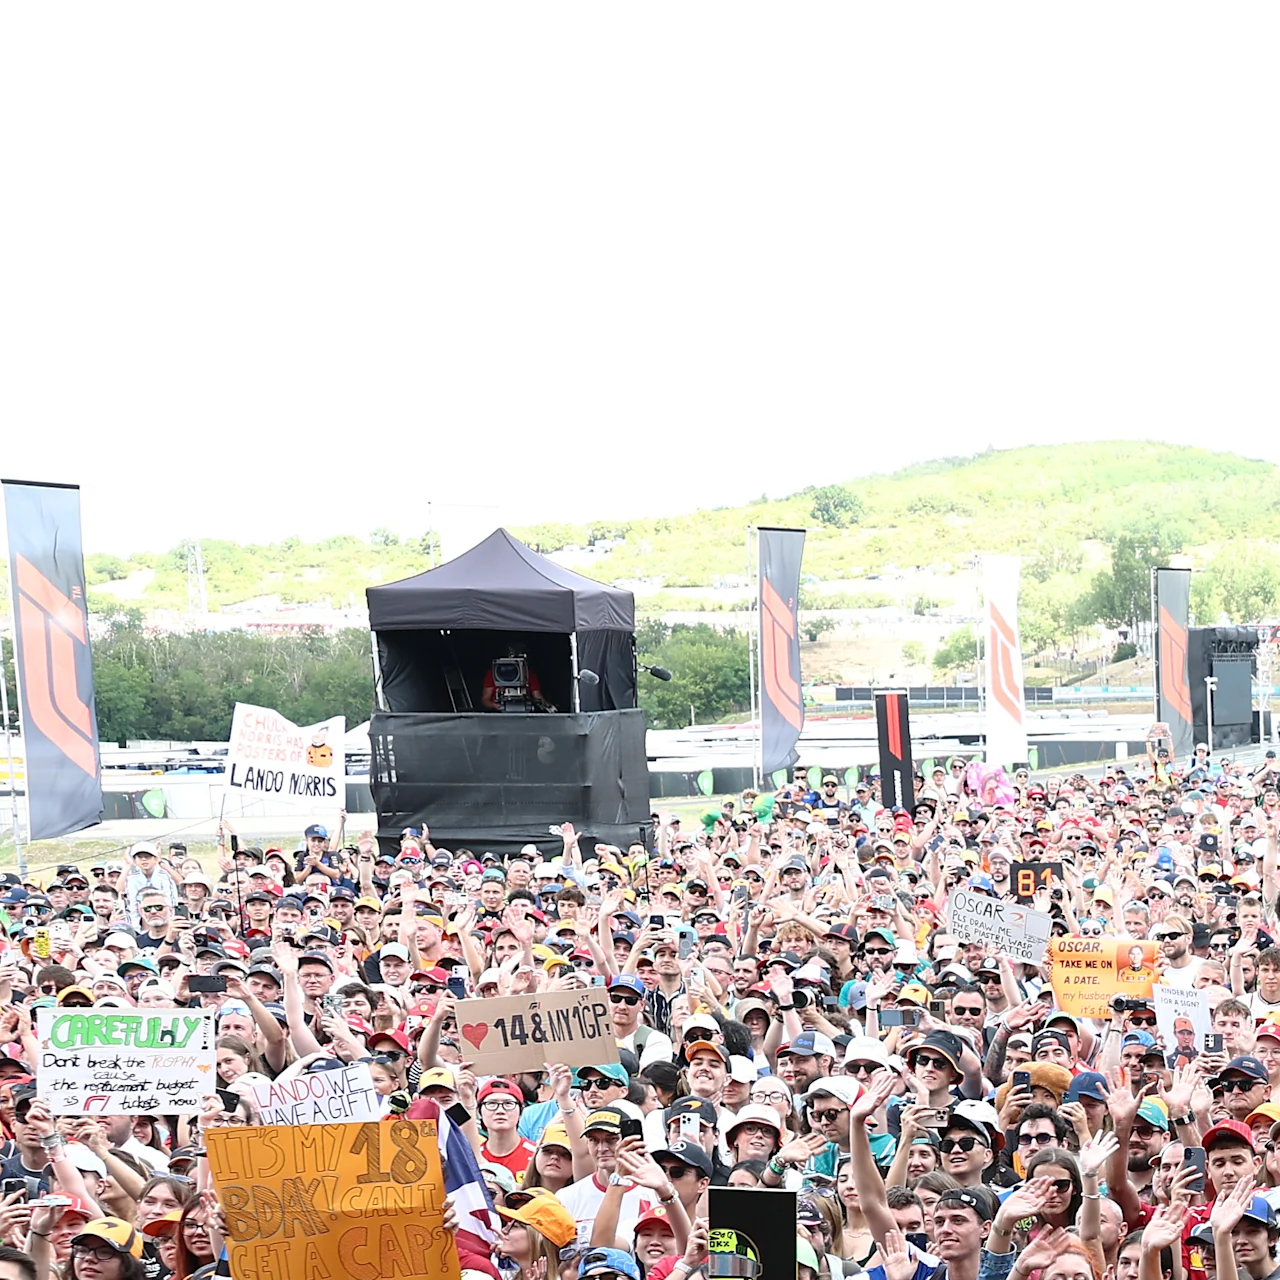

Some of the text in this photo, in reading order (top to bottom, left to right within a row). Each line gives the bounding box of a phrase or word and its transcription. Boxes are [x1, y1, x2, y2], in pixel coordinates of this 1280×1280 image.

[236, 744, 287, 762] POSTERS
[231, 763, 336, 796] LANDO NORRIS
[954, 892, 1005, 922] OSCAR
[952, 910, 1012, 938] PLS DRAW ME
[953, 921, 1033, 950] THE PIASTRI WASP
[953, 928, 1033, 959] FOR TATTOO
[1058, 941, 1103, 954] OSCAR,
[1059, 960, 1112, 969] TAKE ME ON
[1073, 977, 1100, 985] DATE.
[1062, 993, 1076, 1001] my
[1161, 988, 1198, 998] KINDER JOY
[1081, 1006, 1096, 1015] it's
[51, 1014, 202, 1049] CAREFULLY
[493, 1009, 574, 1048] 14 & MY
[87, 1054, 198, 1070] break the TROPHY
[93, 1069, 138, 1081] cause
[328, 1066, 360, 1095] WE
[50, 1079, 199, 1095] the replacement budget
[63, 1096, 79, 1107] is
[260, 1088, 374, 1125] HAVE A GIFT
[209, 1120, 437, 1185] IT'S MY 18th
[220, 1175, 442, 1243] BDAY! CAN I
